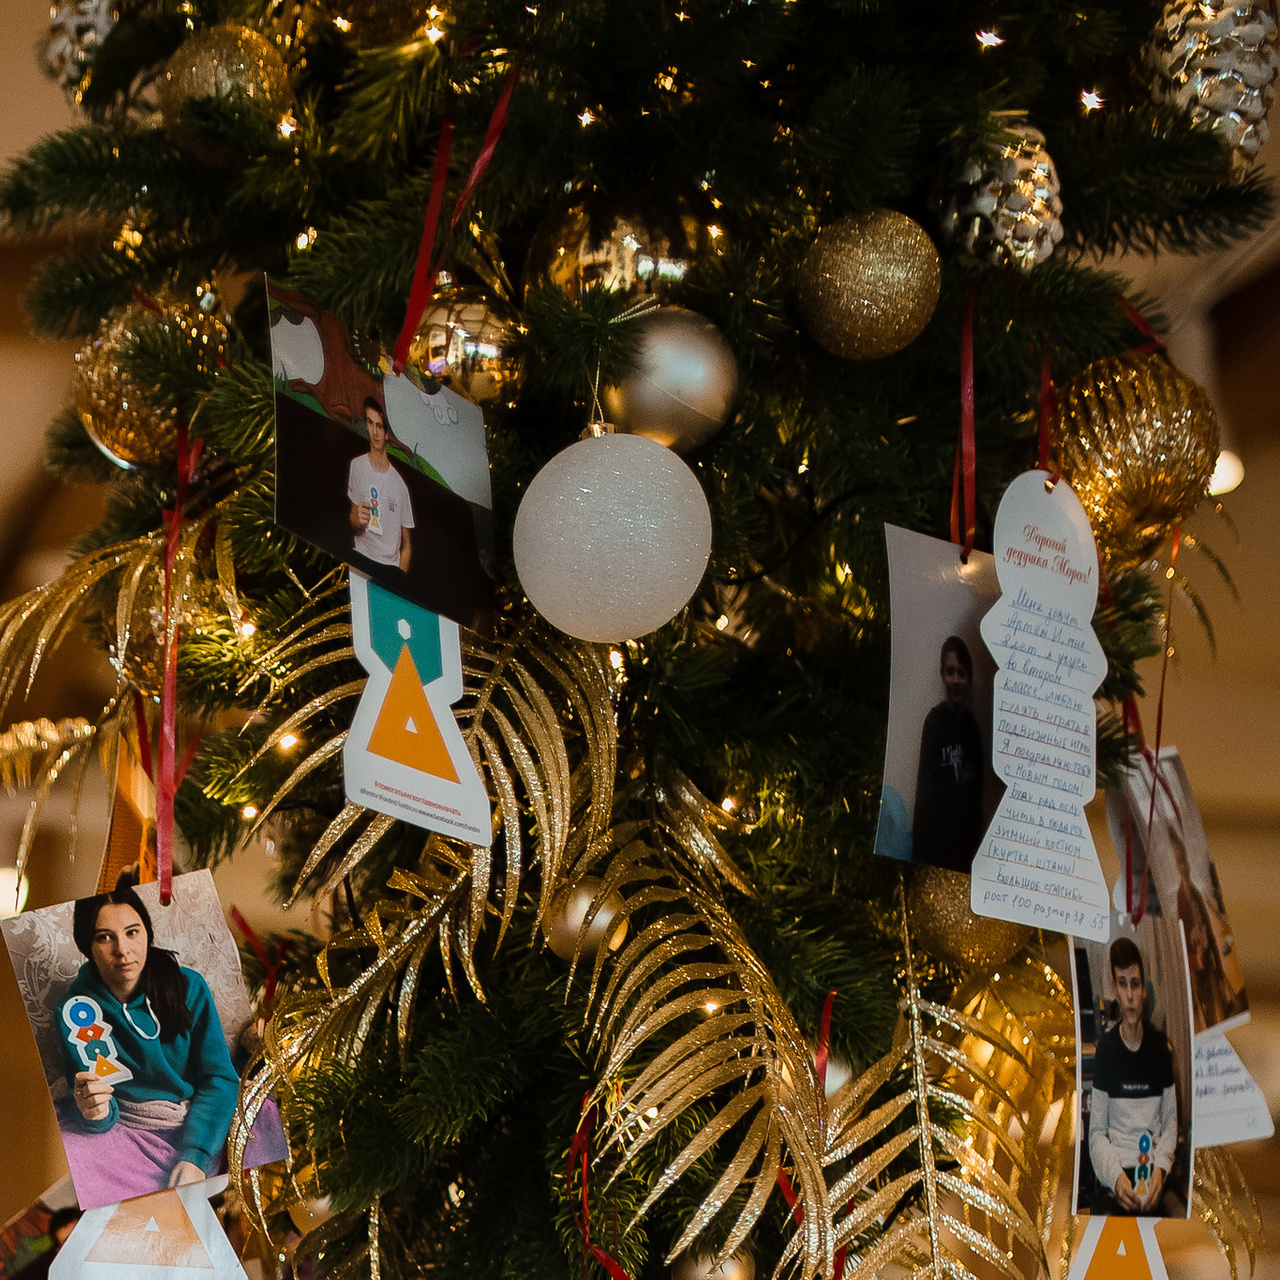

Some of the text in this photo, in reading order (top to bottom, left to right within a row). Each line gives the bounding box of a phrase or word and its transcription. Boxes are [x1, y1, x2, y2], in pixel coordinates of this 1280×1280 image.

[1023, 524, 1067, 553] Дорогой
[1003, 546, 1092, 585] дедушка Мороз!
[983, 890, 1010, 905] рост
[1033, 902, 1071, 924] размер
